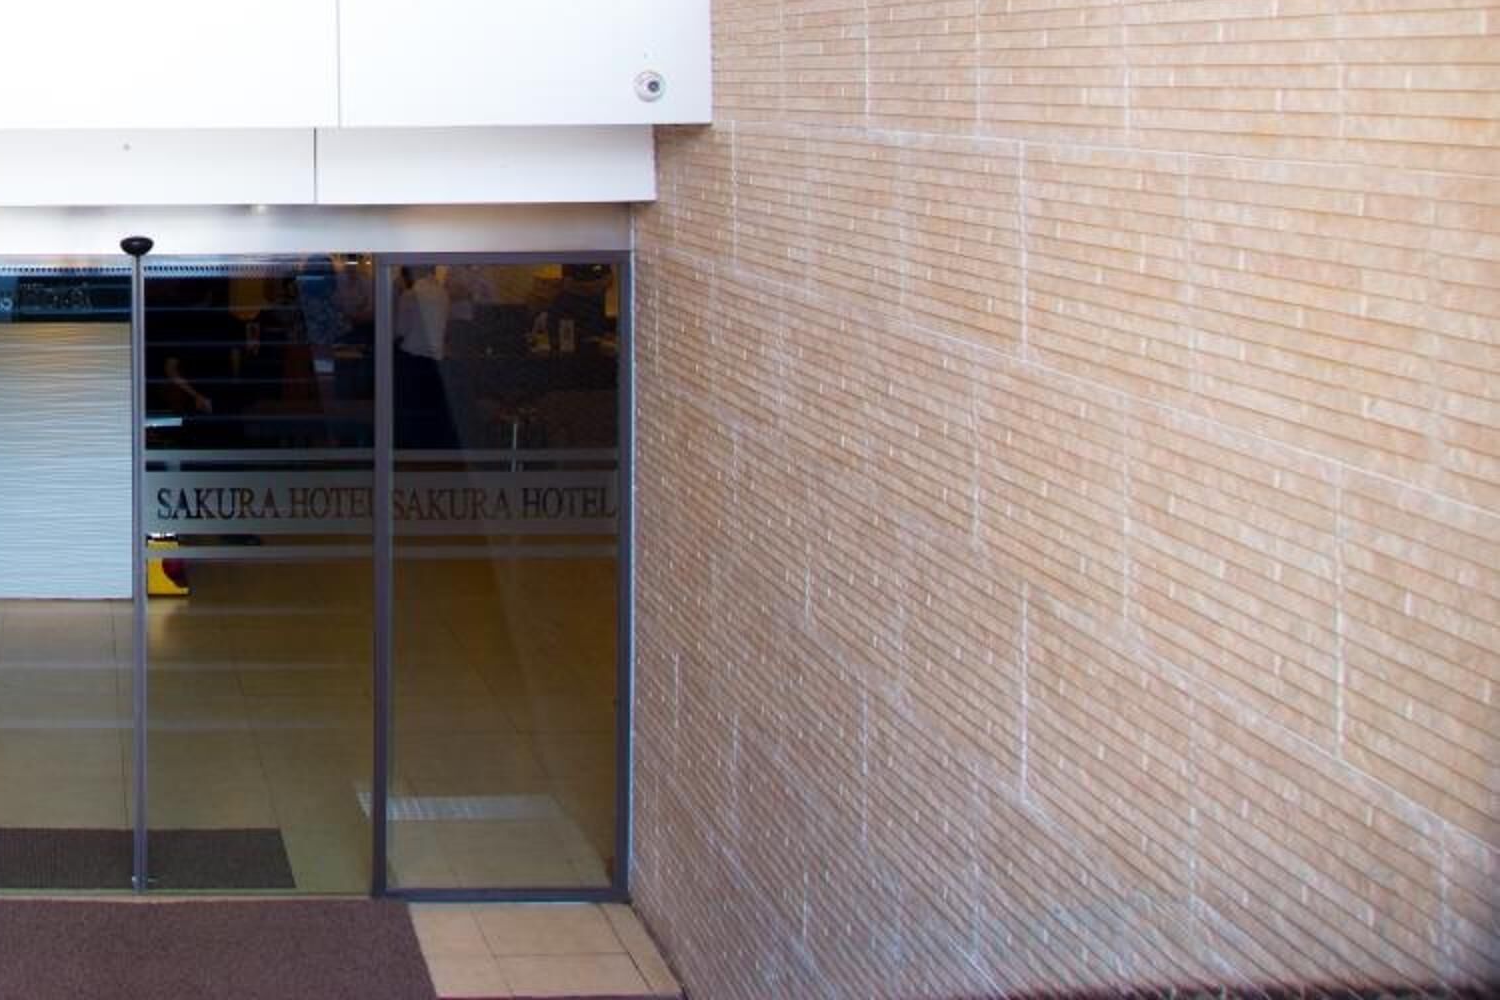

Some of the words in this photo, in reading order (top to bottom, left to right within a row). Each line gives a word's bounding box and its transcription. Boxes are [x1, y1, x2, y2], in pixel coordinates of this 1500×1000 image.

[156, 487, 279, 520] SAKURA
[392, 487, 509, 520] SAKURA
[521, 487, 616, 519] HOTEL
